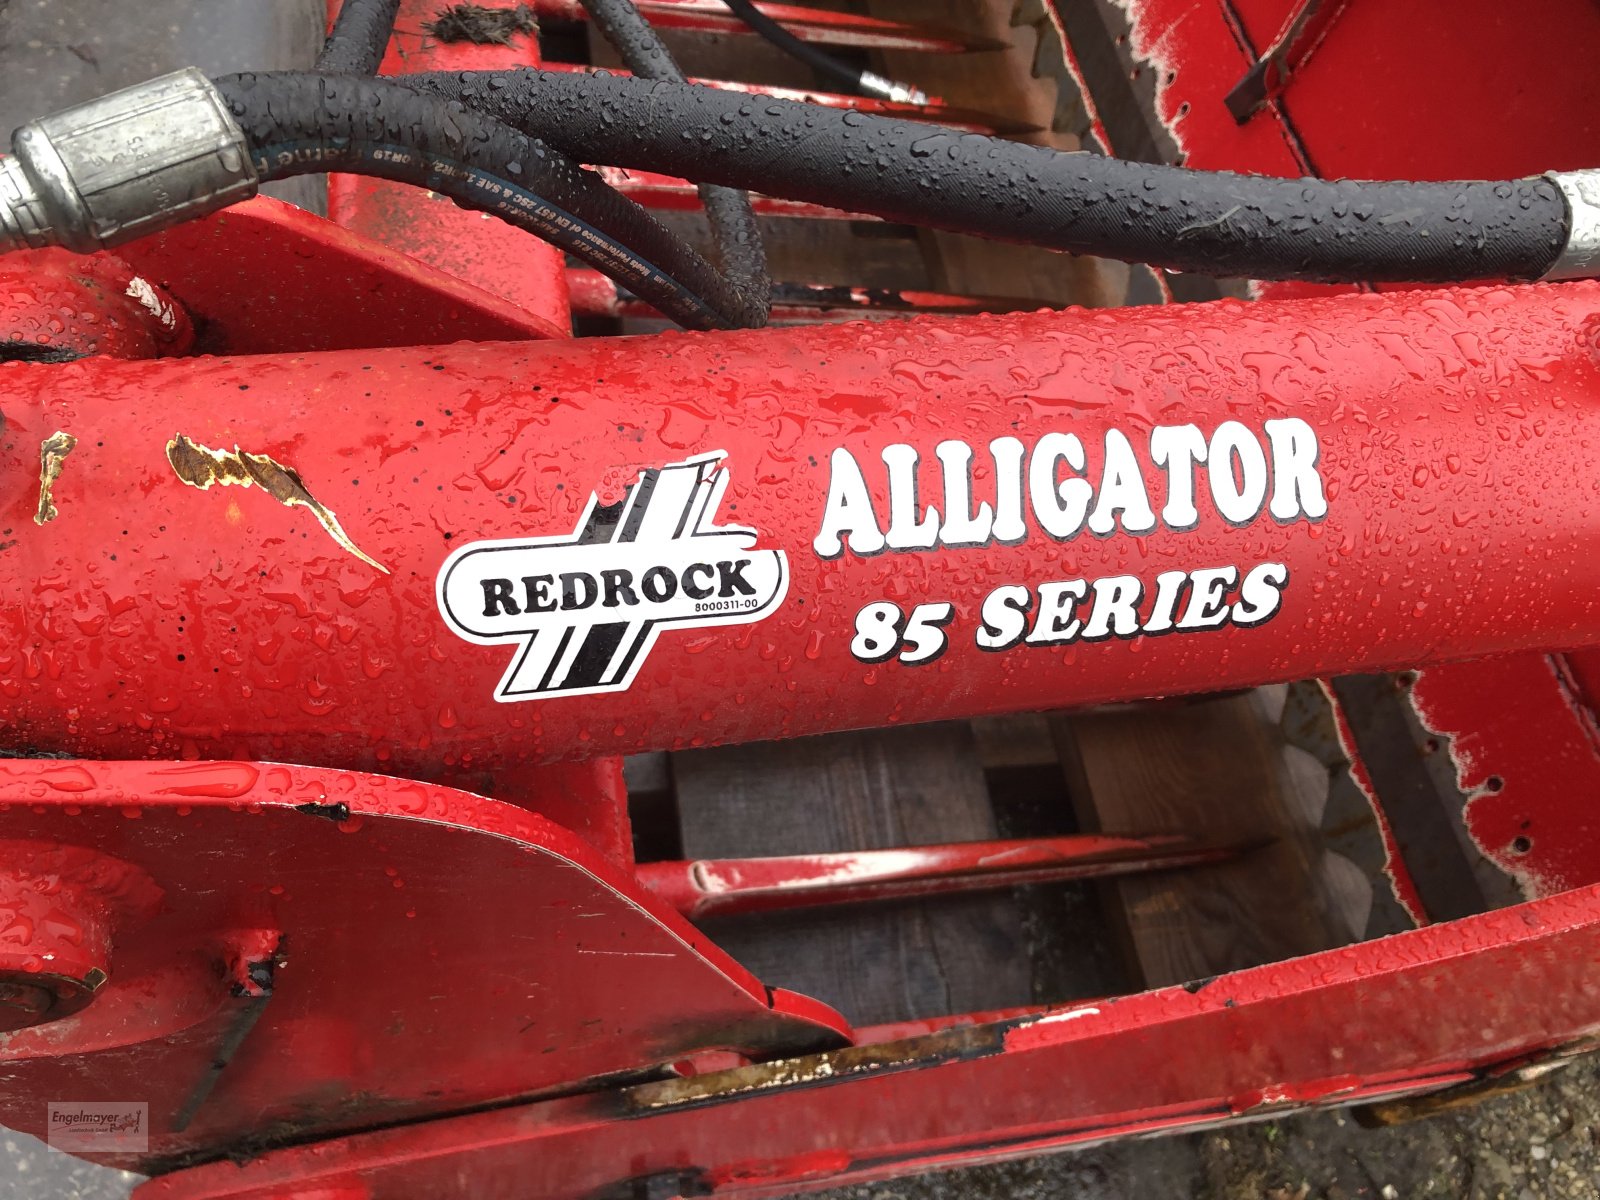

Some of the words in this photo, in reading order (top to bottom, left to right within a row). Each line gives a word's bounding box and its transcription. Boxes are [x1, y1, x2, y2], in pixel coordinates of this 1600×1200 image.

[475, 176, 502, 194] SAE
[501, 188, 513, 198] &
[512, 193, 536, 209] 2SC
[555, 215, 570, 227] EN
[813, 417, 1328, 560] ALLIGATOR
[480, 559, 757, 616] REDROCK
[695, 598, 758, 613] 8000311-00
[851, 600, 955, 666] 85
[976, 562, 1290, 652] SERIES
